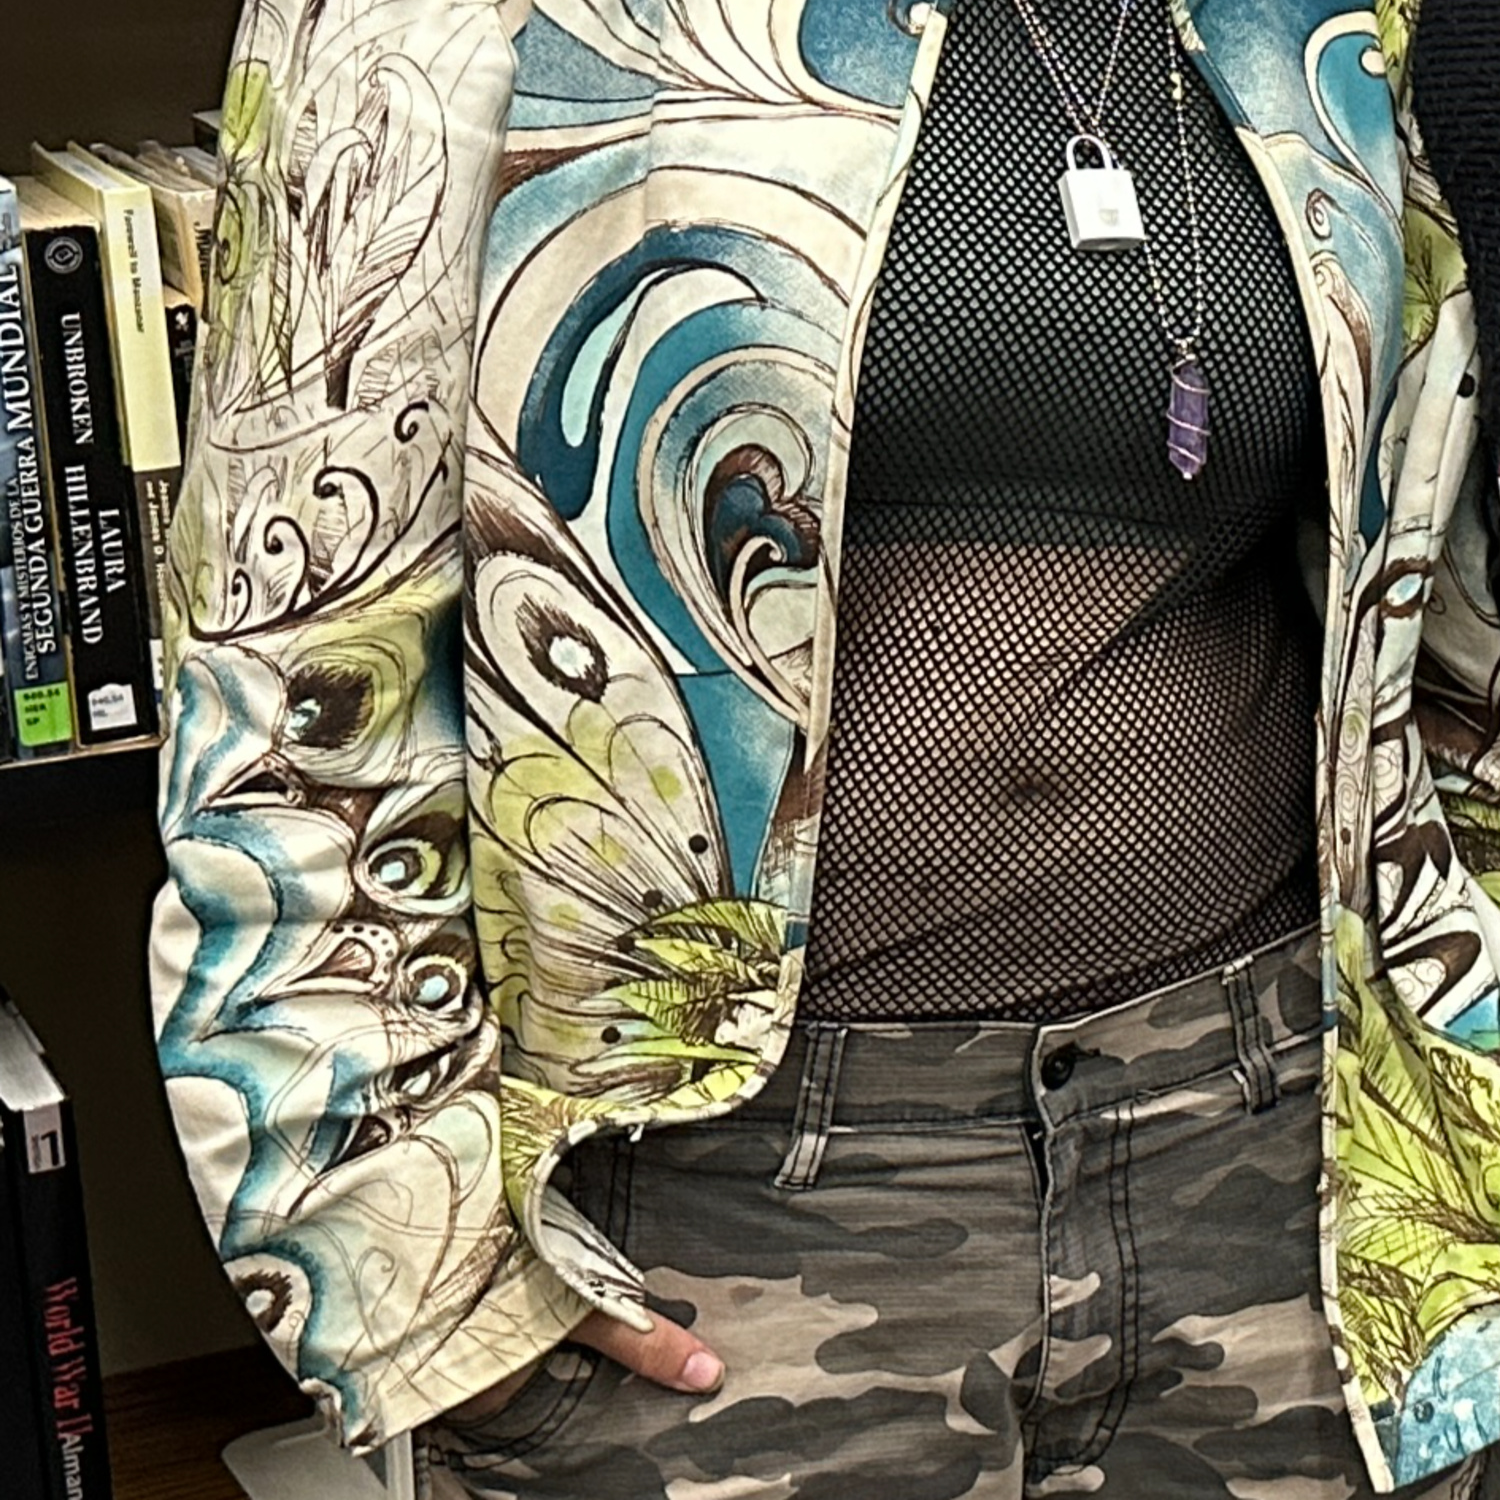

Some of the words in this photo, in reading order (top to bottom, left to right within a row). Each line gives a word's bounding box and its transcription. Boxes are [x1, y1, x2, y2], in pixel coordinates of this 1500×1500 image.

[123, 208, 142, 259] Farewell
[129, 262, 142, 274] to
[0, 264, 33, 430] MUNDIAL
[60, 312, 94, 445] UNBROKEN
[16, 435, 45, 533] GUERRA
[148, 501, 163, 542] James
[11, 517, 33, 599] MISTERIOS
[63, 464, 104, 645] HILLENBRAND
[97, 508, 127, 593] LAURA
[24, 535, 56, 653] SEGUNDA
[20, 611, 40, 680] ENIGMAS
[43, 1276, 85, 1356] World
[52, 1355, 88, 1410] War
